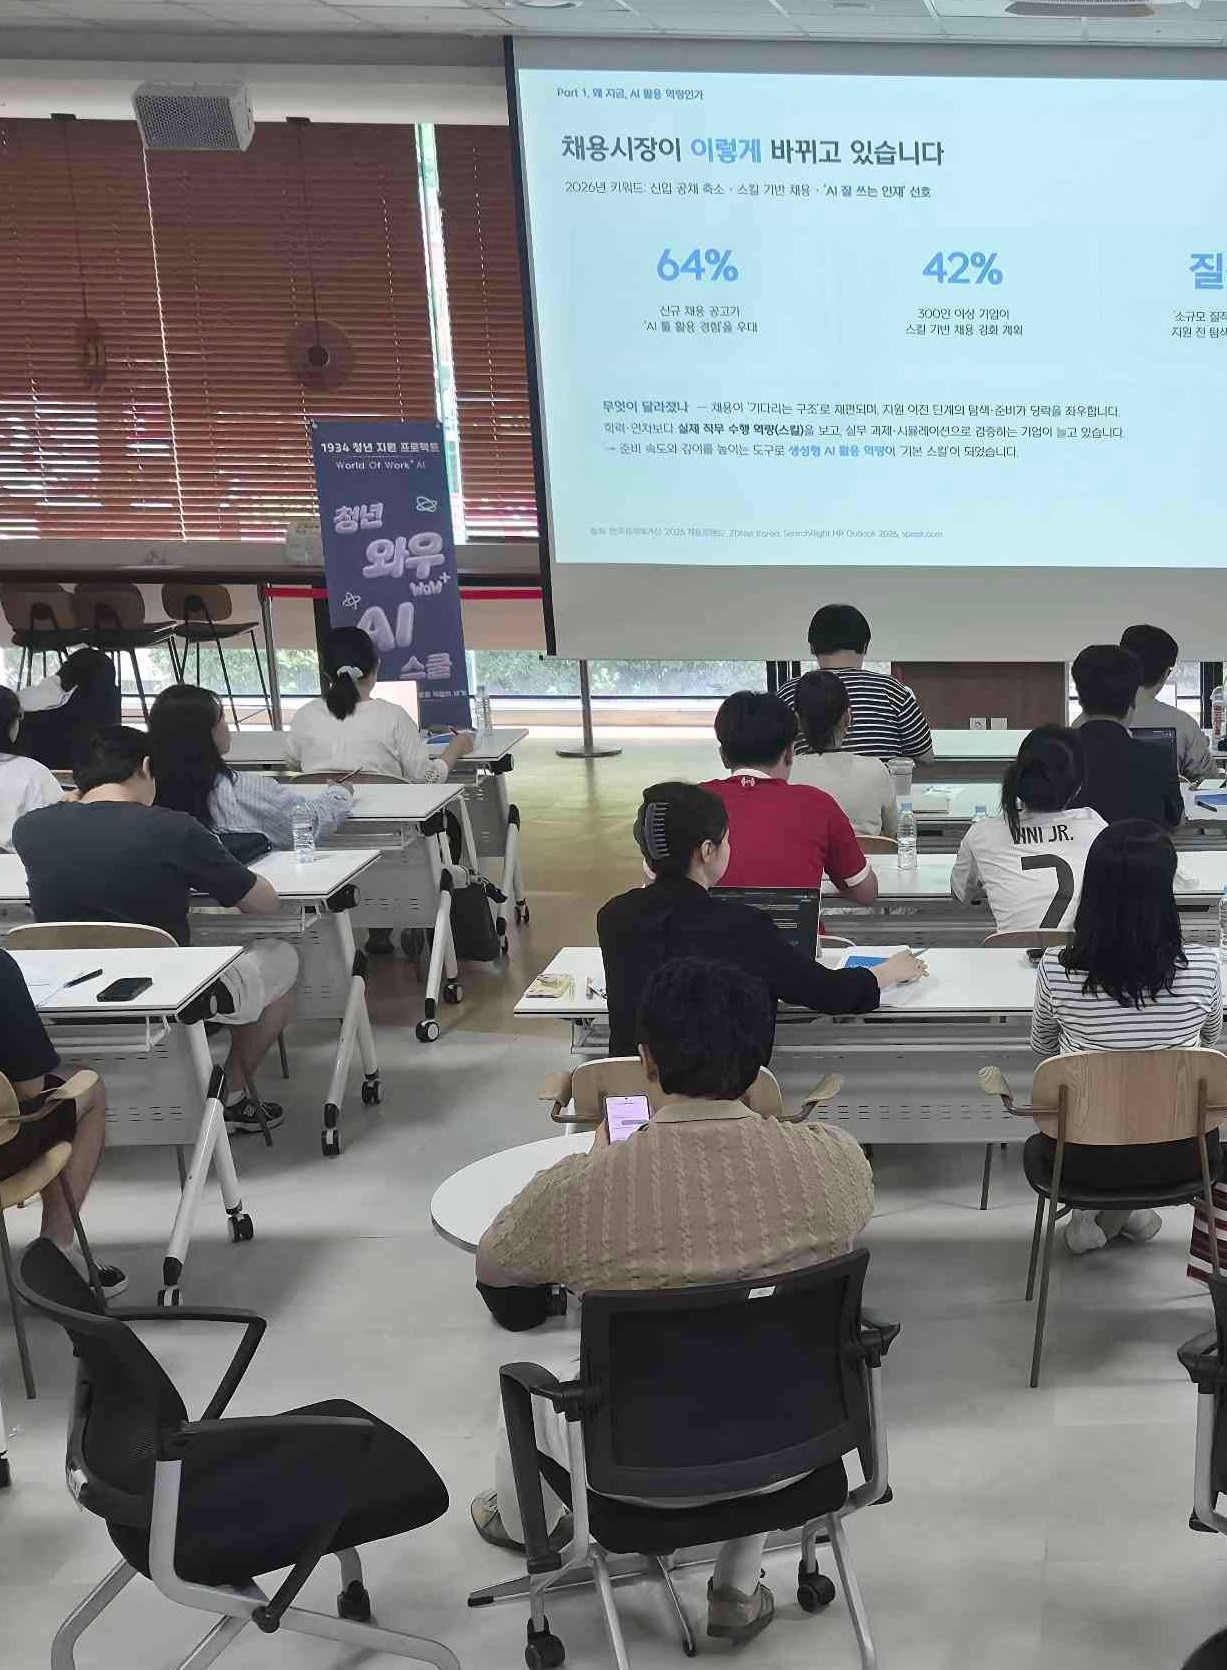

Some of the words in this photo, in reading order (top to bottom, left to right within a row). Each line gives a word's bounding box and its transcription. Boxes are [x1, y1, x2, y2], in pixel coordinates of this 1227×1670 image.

[557, 88, 578, 98] Part
[630, 88, 640, 98] AI
[562, 135, 681, 162] 채용시장이
[690, 137, 761, 164] 이렇게
[771, 139, 841, 164] 바뀌고
[851, 140, 945, 166] 있습니다
[565, 181, 606, 194] 2026년
[610, 181, 646, 194] 키워드:
[651, 182, 672, 195] 신입
[677, 183, 698, 195] 공채
[703, 183, 724, 195] 축소
[738, 184, 759, 196] 스킬
[763, 185, 786, 197] 기반
[789, 185, 810, 197] 채용
[856, 186, 878, 198] 쓰는
[910, 186, 931, 198] 선호
[657, 248, 739, 282] 64%
[922, 251, 1003, 285] 42%
[660, 306, 680, 318] 신규
[685, 306, 704, 318] 채용
[709, 306, 741, 318] 공고가
[918, 308, 952, 320] 300인
[954, 308, 975, 320] 이상
[979, 308, 1009, 320] 기업이
[737, 321, 758, 333] 우대
[905, 323, 926, 336] 스킬
[930, 324, 950, 336] 기반
[954, 324, 974, 336] 채용
[979, 324, 998, 336] 강화
[1002, 324, 1023, 336] 계획
[1171, 326, 1192, 339] 지원
[1196, 327, 1206, 339] 전
[603, 401, 638, 414] 무엇이
[711, 402, 743, 414] 채용이
[882, 404, 904, 416] 지원
[907, 404, 929, 416] 이전
[932, 404, 965, 416] 단계의
[968, 404, 1027, 417] 탐색·준비가
[1030, 405, 1062, 417] 당락을
[1065, 405, 1121, 418] 좌우합니다.
[703, 423, 724, 435] 직무
[728, 424, 750, 436] 수행
[846, 425, 866, 437] 실무
[976, 426, 1018, 438] 검증하는
[1021, 427, 1053, 438] 기업이
[1056, 427, 1078, 439] 늘고
[321, 443, 349, 453] 1934
[353, 442, 373, 453] 청년
[377, 442, 397, 453] 지원
[620, 443, 641, 455] 준비
[717, 444, 749, 455] 높이는
[753, 445, 785, 456] 도구로
[788, 445, 821, 457] 생성형
[824, 446, 835, 456] AI
[336, 460, 365, 470] World
[368, 461, 381, 470] Of
[417, 461, 426, 469] AI
[334, 502, 384, 534] 청년
[362, 532, 445, 579] 와우
[357, 602, 415, 652] AI
[401, 653, 452, 680] 스쿨
[1048, 824, 1074, 843] JR.
[1021, 853, 1075, 929] 7
